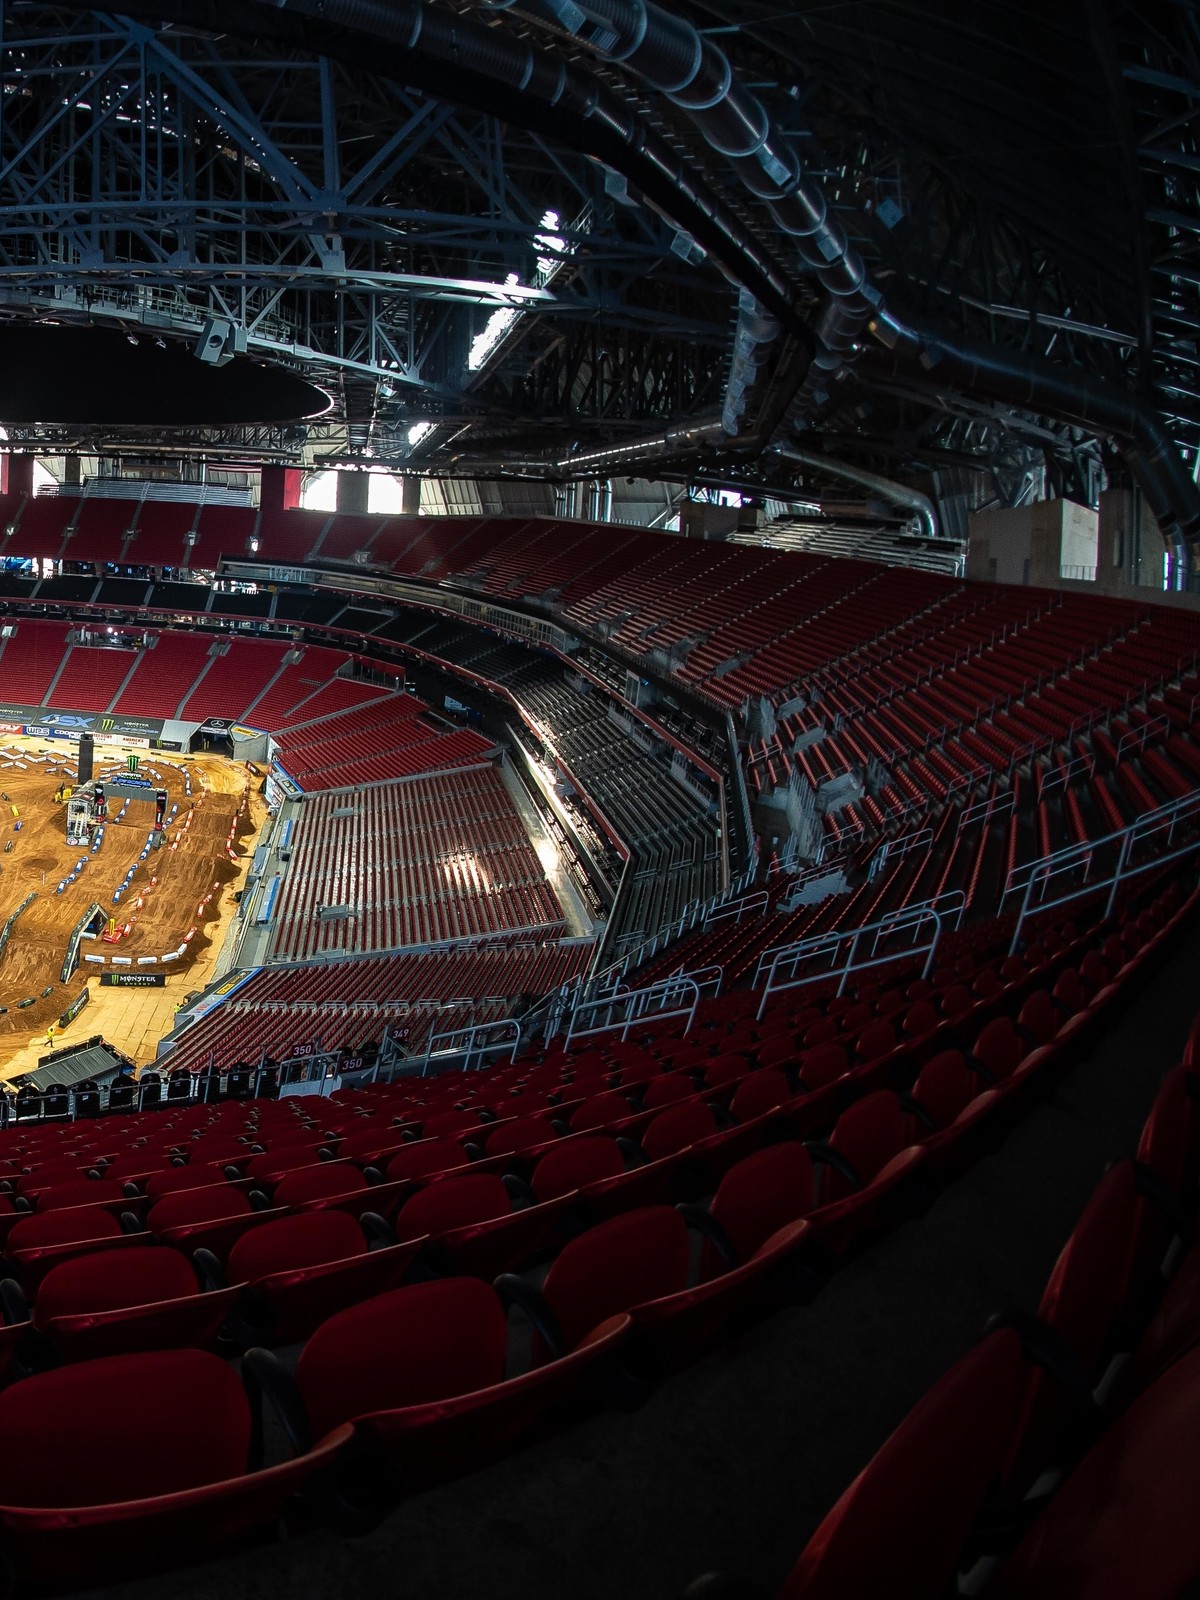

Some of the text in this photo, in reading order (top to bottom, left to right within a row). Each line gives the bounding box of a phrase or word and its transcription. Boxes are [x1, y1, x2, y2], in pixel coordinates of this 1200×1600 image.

[392, 1028, 410, 1039] 349
[293, 1044, 312, 1056] 350
[342, 1058, 363, 1070] 350
